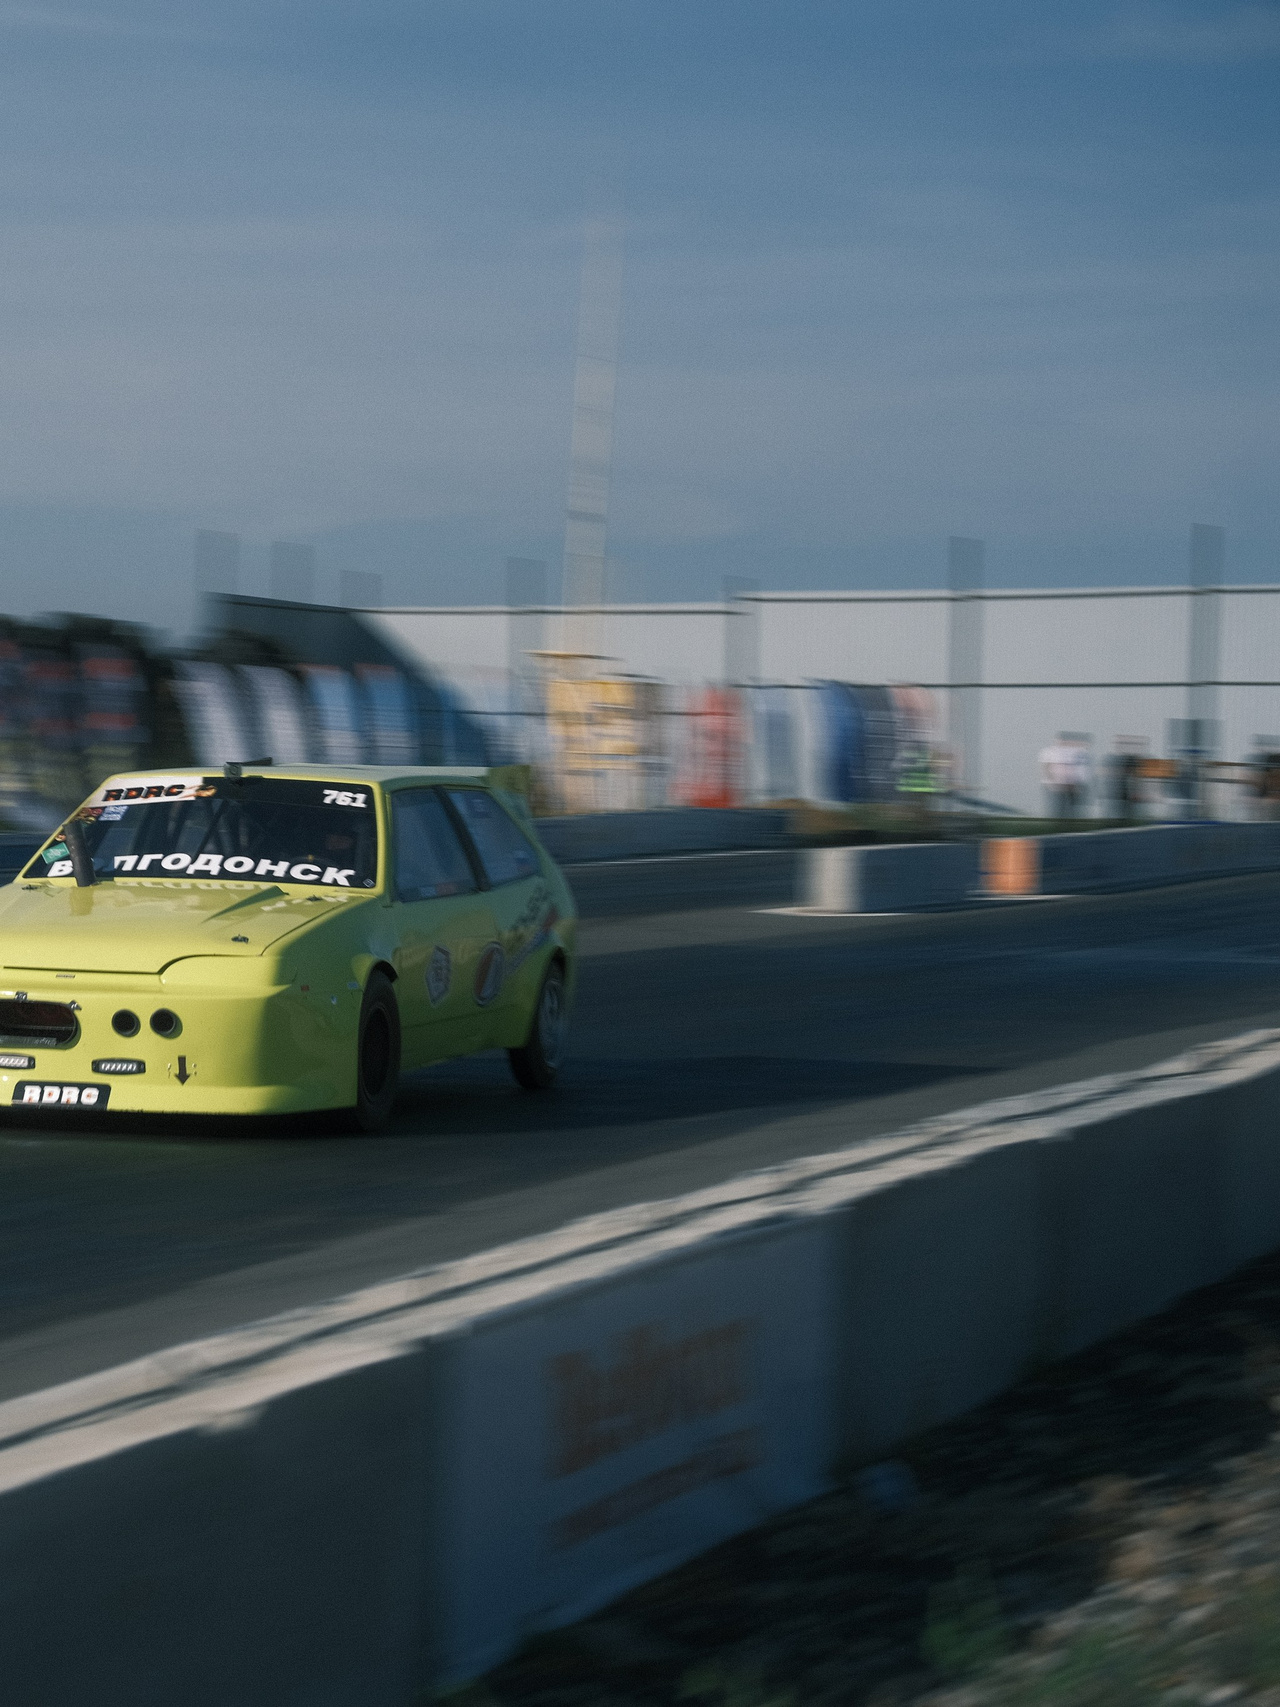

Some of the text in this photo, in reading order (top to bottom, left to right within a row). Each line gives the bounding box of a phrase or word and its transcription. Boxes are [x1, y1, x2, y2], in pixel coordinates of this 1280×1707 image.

[102, 784, 186, 802] RDRC
[322, 789, 368, 809] 761
[22, 1084, 100, 1106] RDRC
